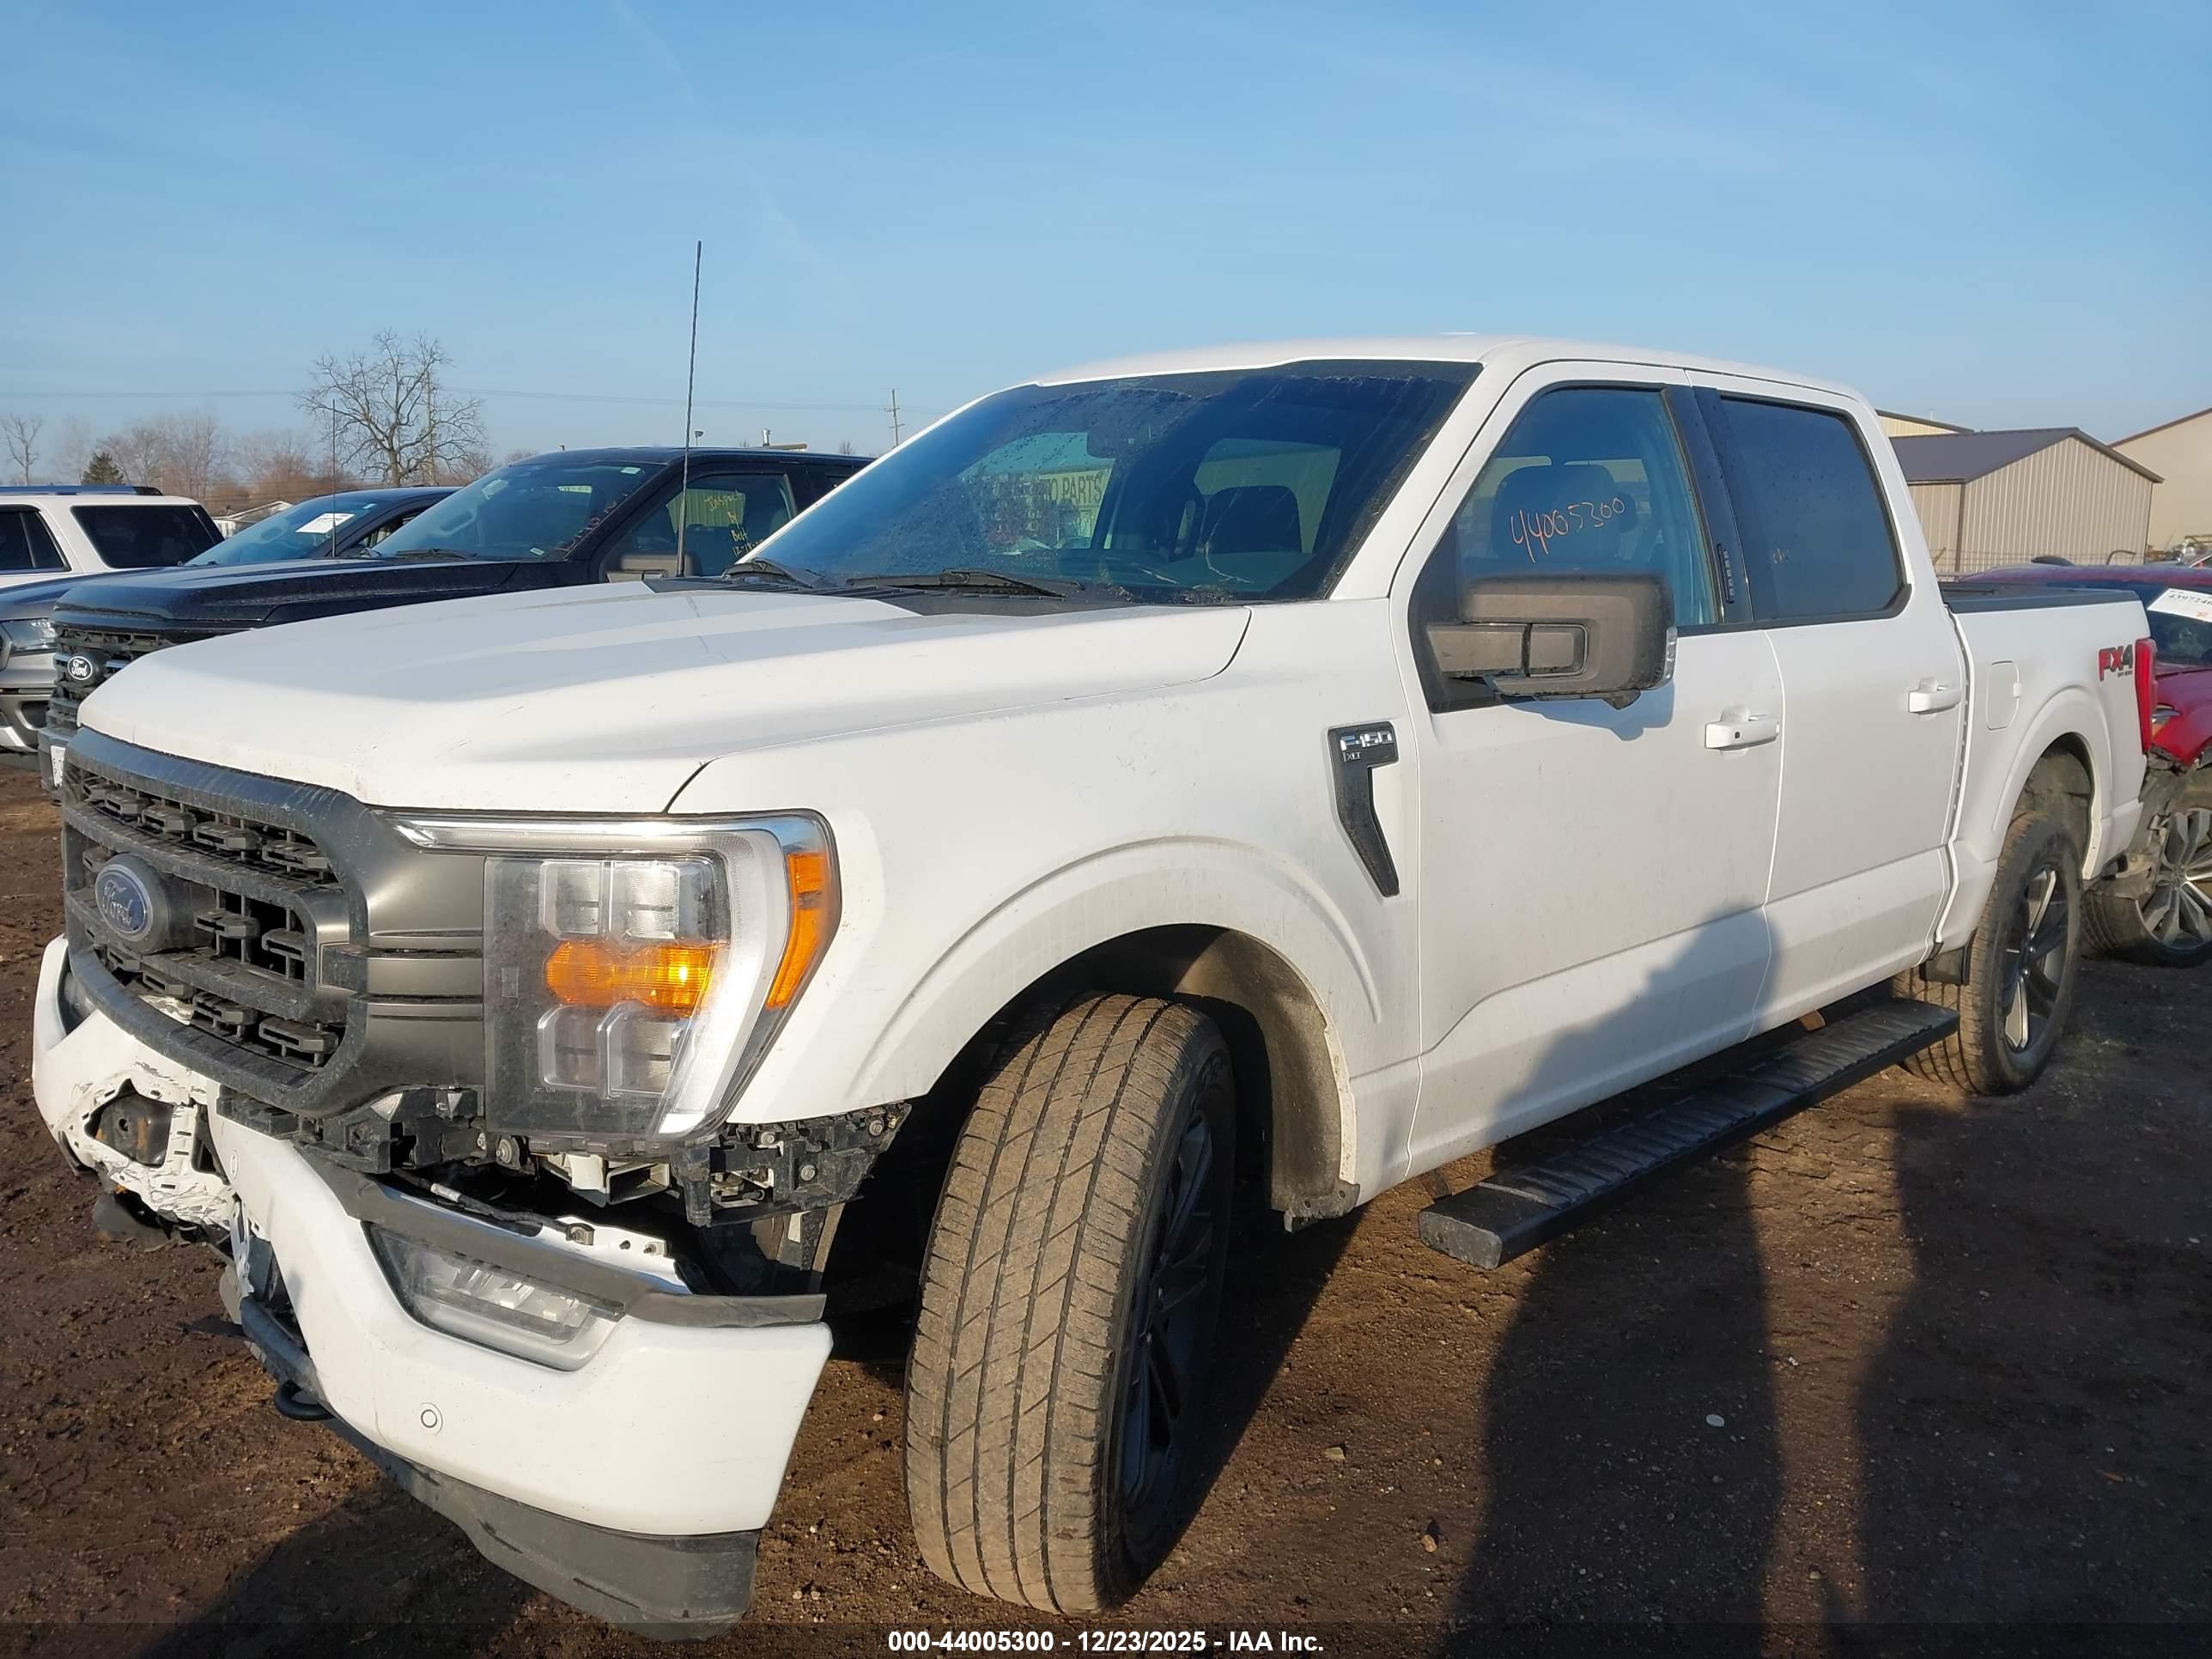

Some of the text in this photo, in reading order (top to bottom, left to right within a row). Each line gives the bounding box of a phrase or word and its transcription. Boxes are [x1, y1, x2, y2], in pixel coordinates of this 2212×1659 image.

[1062, 473, 1103, 504] PARTS
[1510, 496, 1626, 563] 44005300
[71, 659, 88, 677] Ford
[2098, 643, 2133, 682] FX4
[1340, 730, 1394, 751] F-150
[1346, 750, 1361, 762] XLT
[102, 878, 133, 927] Ford
